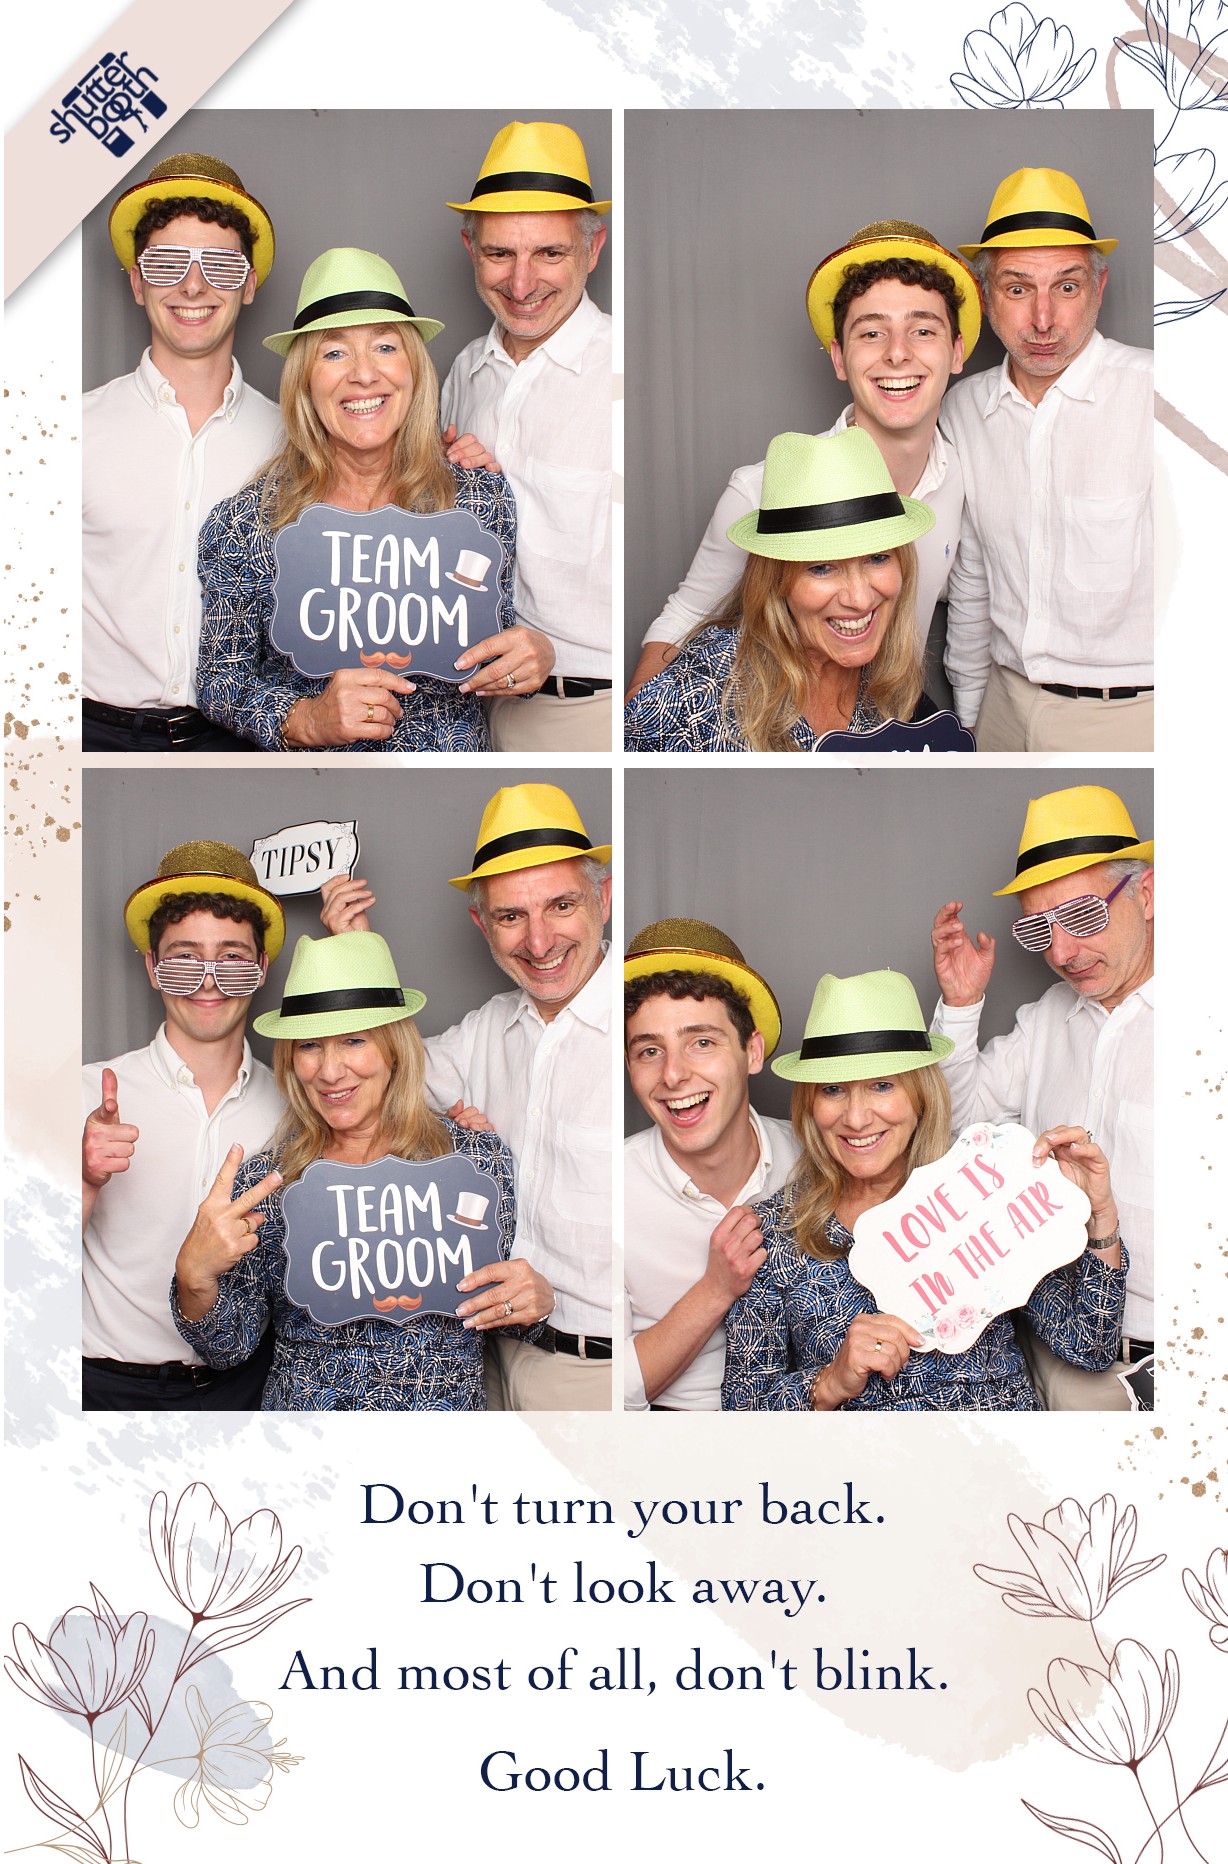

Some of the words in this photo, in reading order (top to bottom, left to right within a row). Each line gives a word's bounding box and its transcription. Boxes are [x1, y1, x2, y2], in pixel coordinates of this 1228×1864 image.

[322, 531, 439, 589] TEAM
[300, 587, 468, 652] GROOM
[262, 837, 343, 879] TIPSY
[326, 1182, 442, 1237] TEAM
[882, 1183, 968, 1262] LOVE
[957, 1154, 1004, 1200] IS
[312, 1234, 473, 1299] GROOM
[909, 1271, 954, 1316] IN
[949, 1221, 1010, 1279] THE
[1007, 1181, 1063, 1239] AIR
